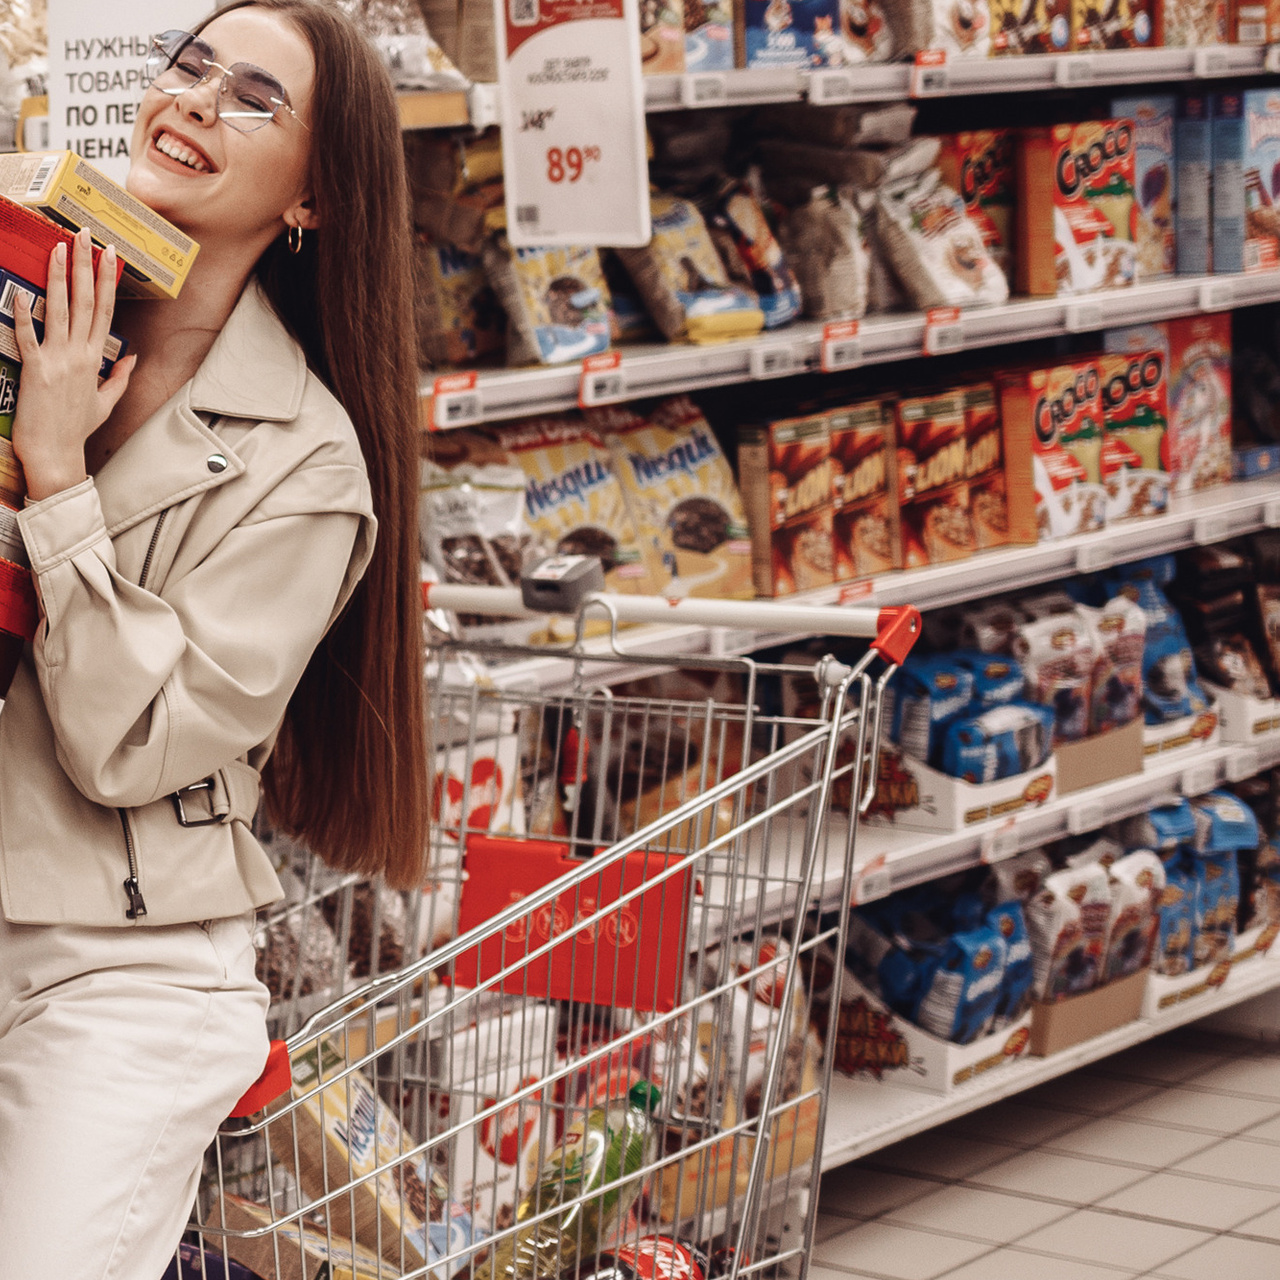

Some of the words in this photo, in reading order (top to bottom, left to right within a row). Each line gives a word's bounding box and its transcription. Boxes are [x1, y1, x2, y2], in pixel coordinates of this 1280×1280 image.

[64, 34, 162, 61] НУЖНЫ
[66, 105, 98, 126] ПО
[106, 102, 141, 125] ПЕ
[547, 147, 583, 183] 89
